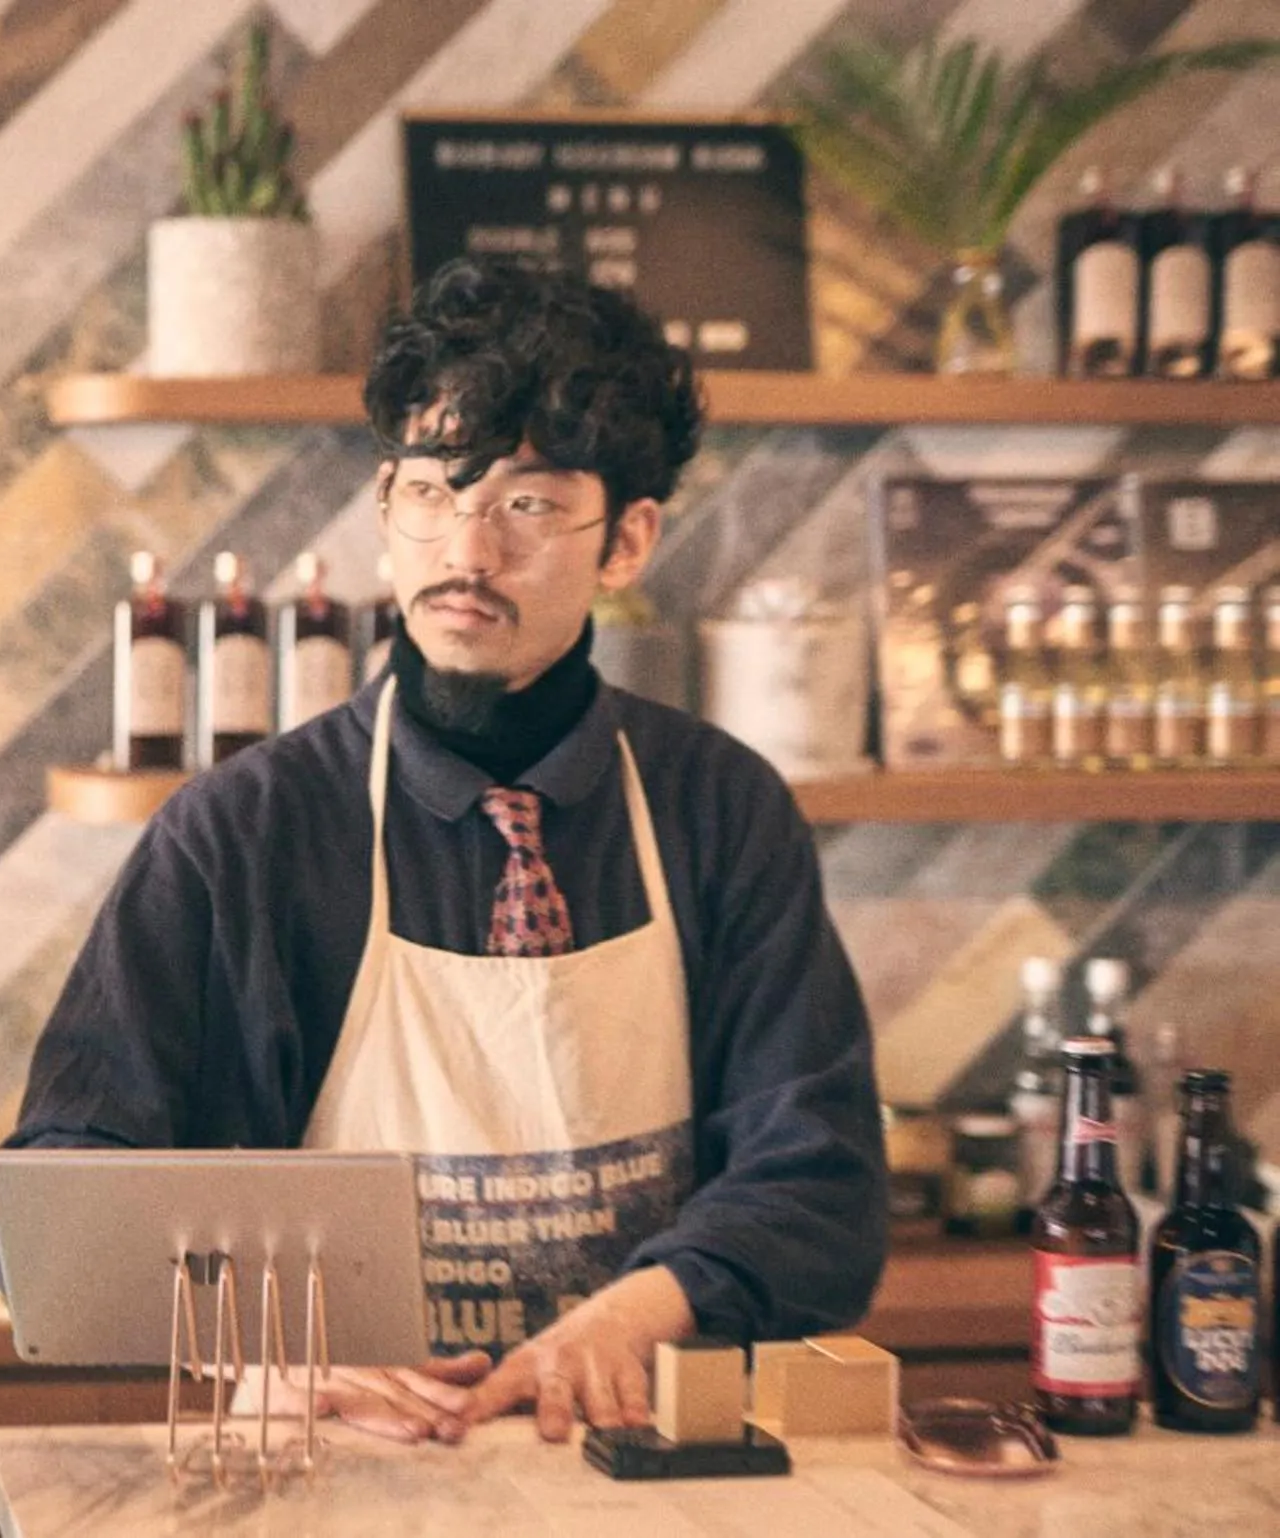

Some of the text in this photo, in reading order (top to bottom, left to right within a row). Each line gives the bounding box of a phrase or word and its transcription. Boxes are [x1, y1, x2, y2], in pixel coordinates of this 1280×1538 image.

[483, 1171, 594, 1203] INDIGO
[599, 1152, 663, 1191] BLUE
[433, 1209, 616, 1246] BLUER THAN
